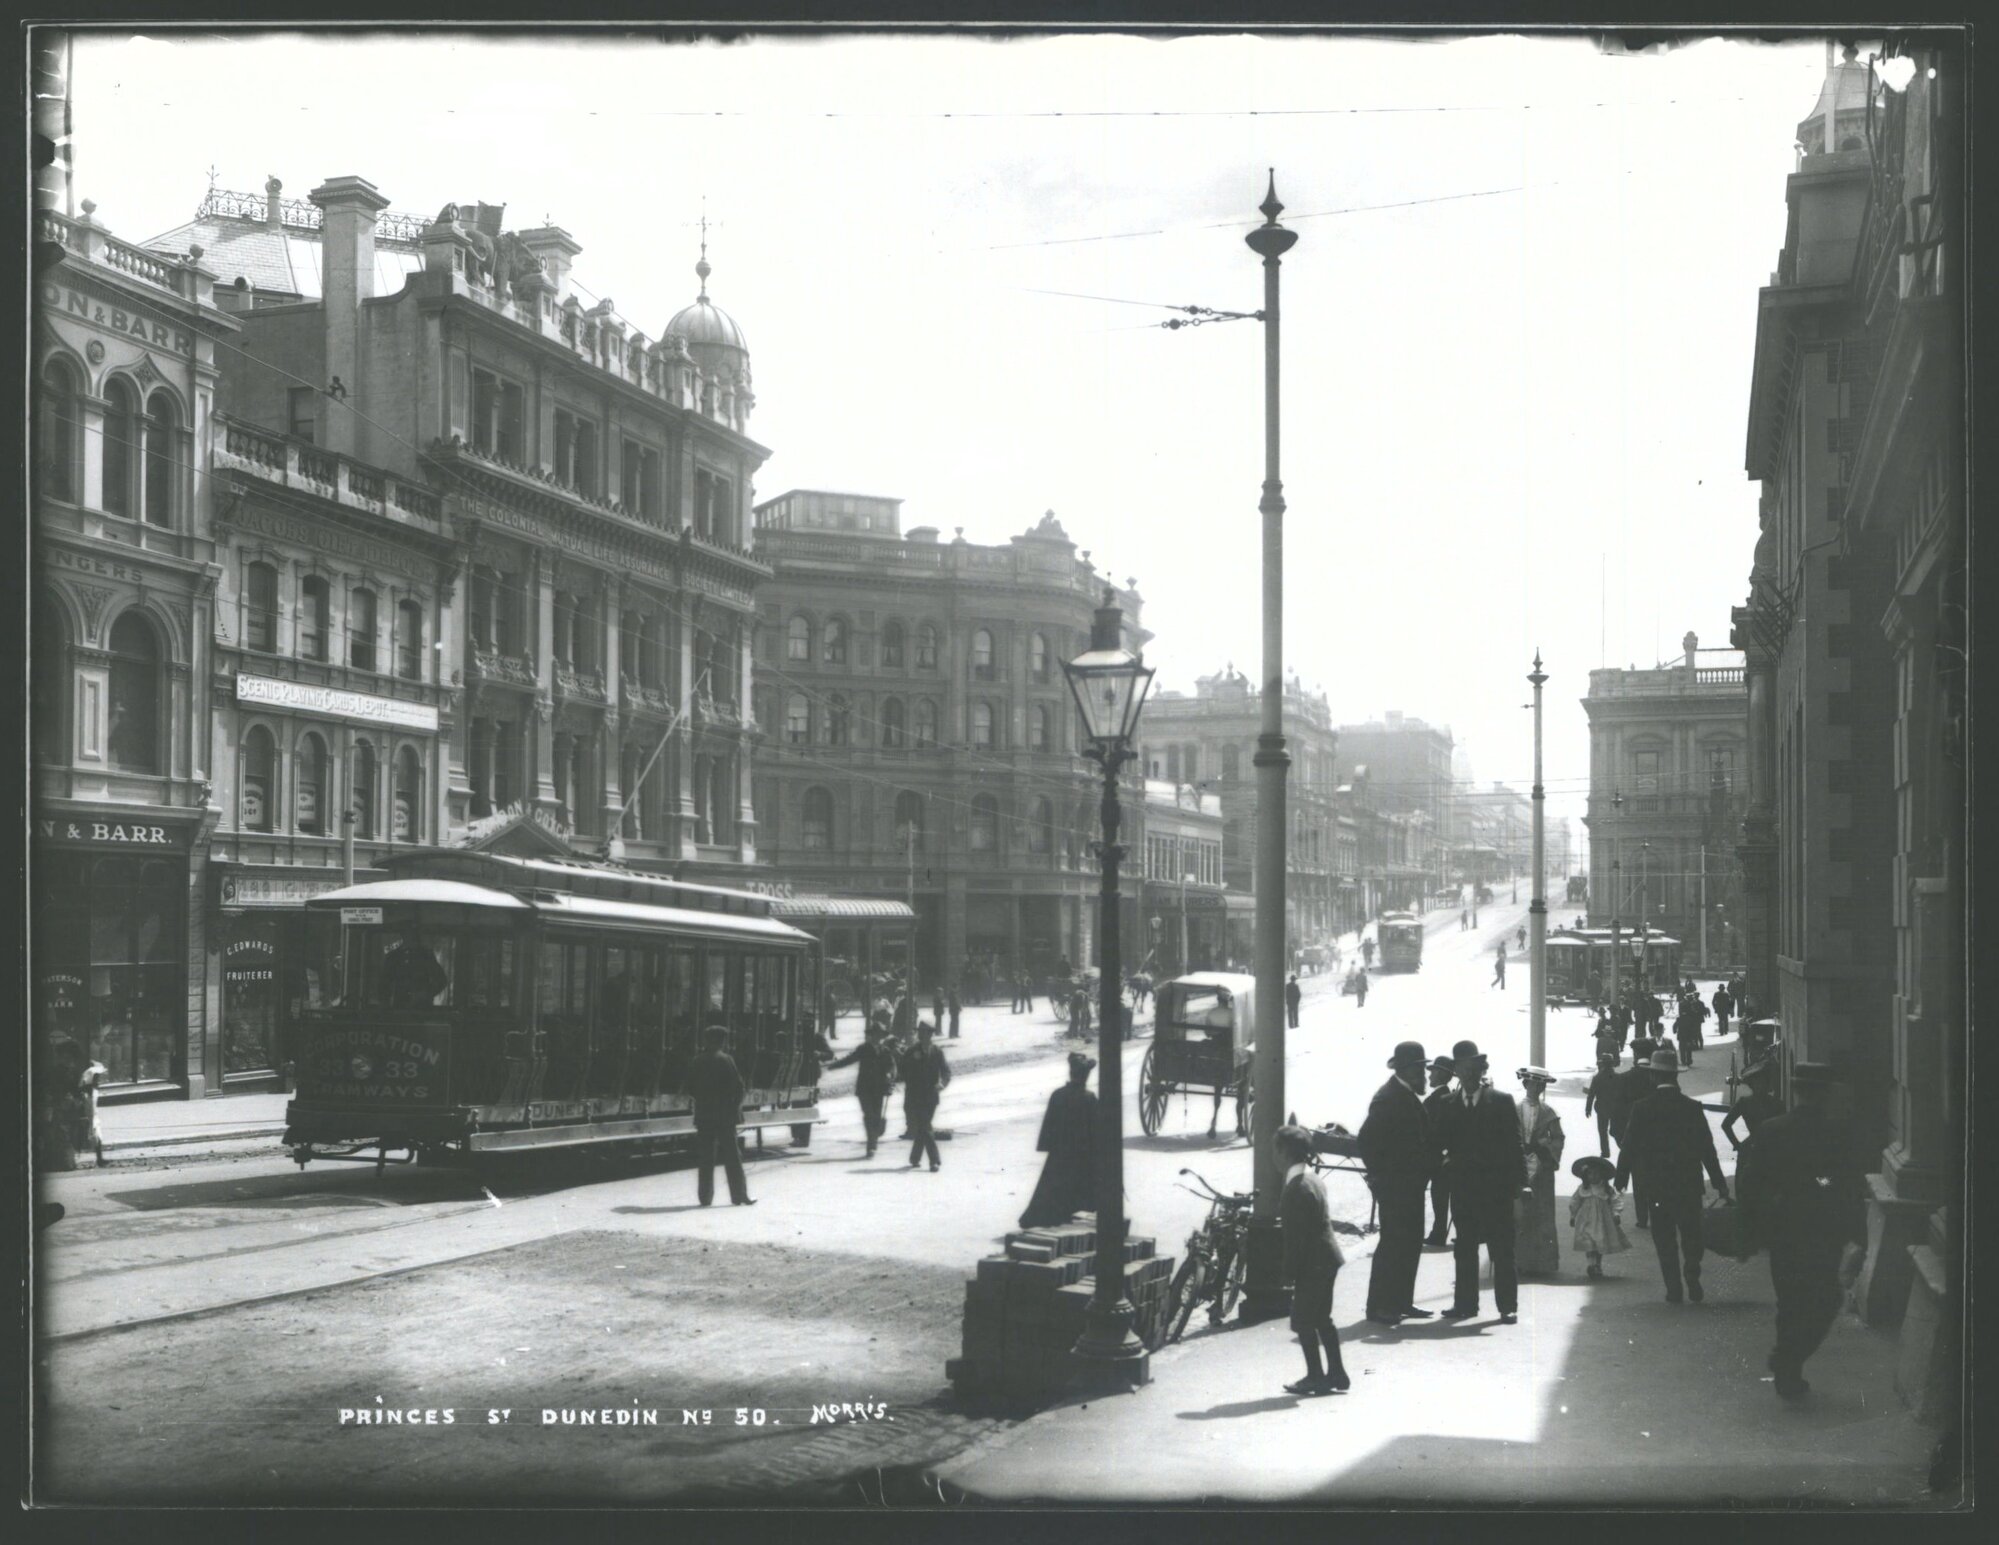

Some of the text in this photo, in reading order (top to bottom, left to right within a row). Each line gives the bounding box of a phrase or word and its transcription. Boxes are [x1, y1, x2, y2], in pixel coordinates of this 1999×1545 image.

[110, 307, 191, 357] BARR
[460, 496, 484, 516] THE
[488, 505, 544, 537] COLONIAL
[551, 530, 590, 554] MUTUAL
[593, 544, 616, 563] LIFE
[619, 552, 673, 581] ASSURANCE
[685, 571, 719, 595] SOCIETY
[238, 674, 281, 701] SCENIC
[281, 682, 325, 708] PLAYING
[325, 689, 356, 713] CARDS
[67, 822, 83, 840] &
[91, 822, 173, 845] BARR.
[226, 970, 273, 981] FRUITERER
[303, 1031, 440, 1066] CORPORATION
[385, 1060, 418, 1079] 33
[531, 1102, 600, 1120] DUNEDN
